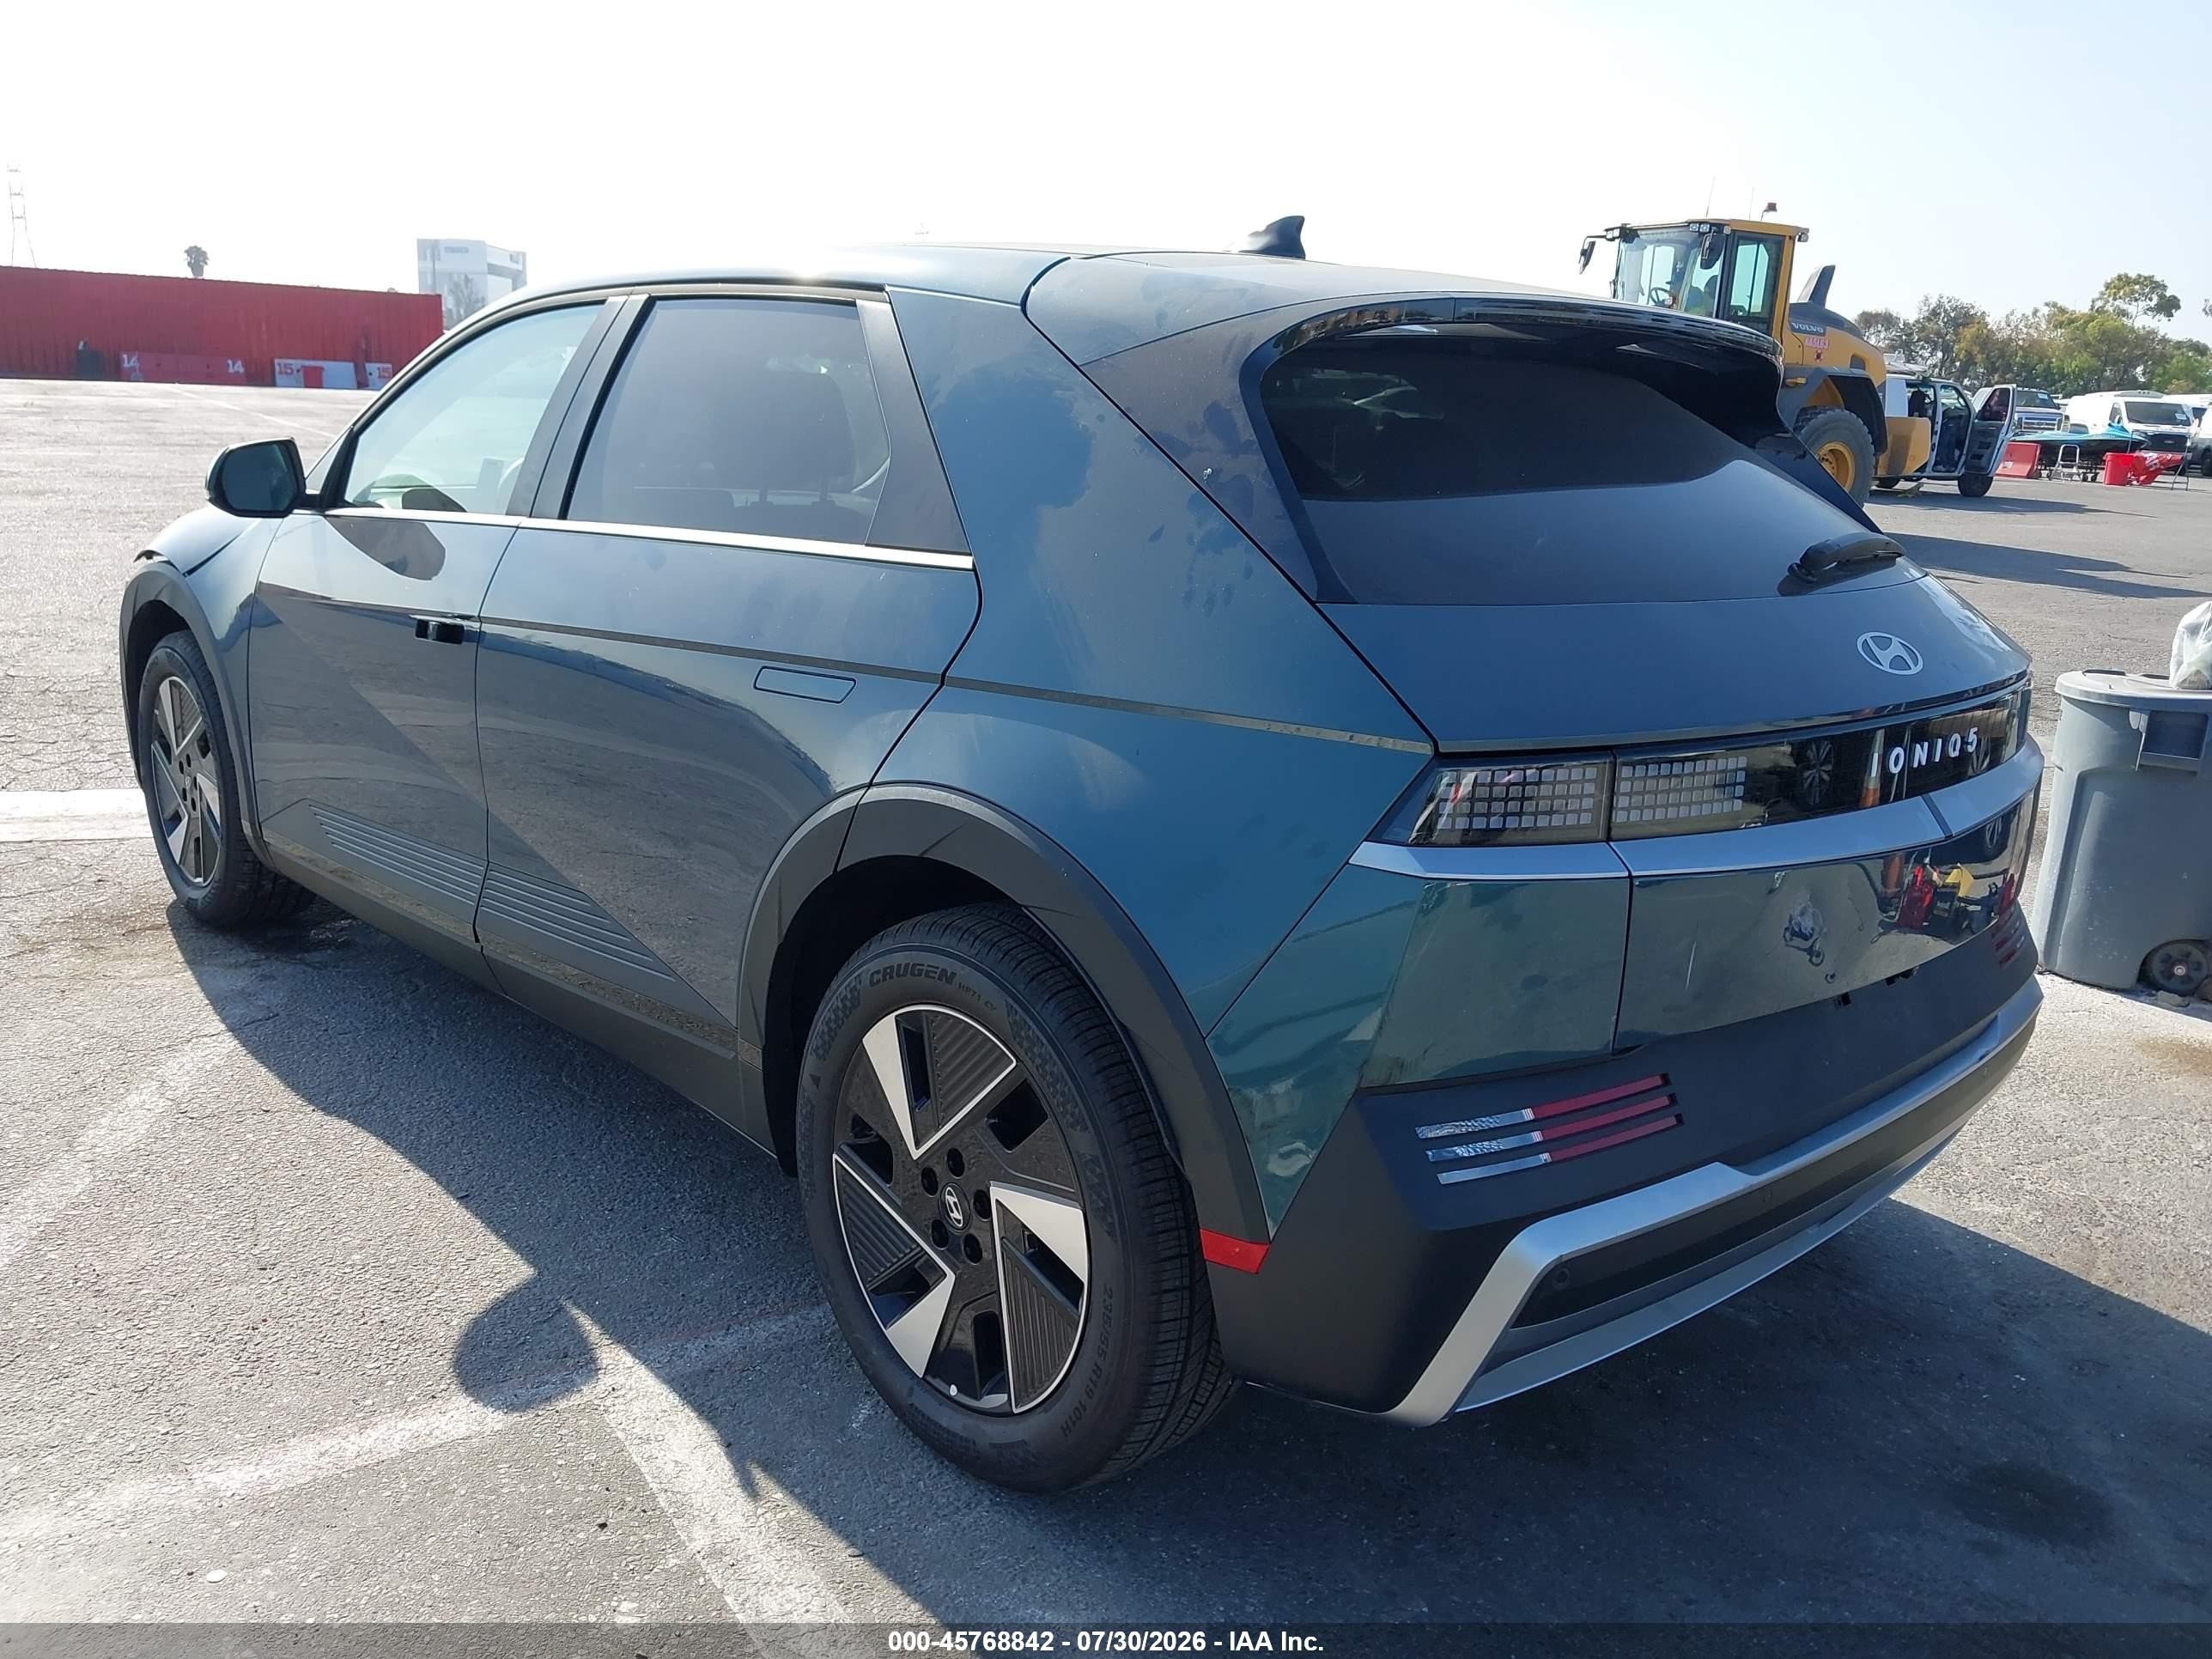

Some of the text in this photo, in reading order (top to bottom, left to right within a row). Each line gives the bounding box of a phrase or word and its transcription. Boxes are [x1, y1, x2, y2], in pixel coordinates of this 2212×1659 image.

[1791, 322, 1824, 333] VOLVO
[121, 354, 139, 368] 14
[227, 359, 245, 374] 14
[276, 362, 295, 375] 15
[377, 366, 392, 379] 15
[869, 963, 957, 988] CRUGEN
[1060, 1282, 1114, 1437] 235/55 R19 101H
